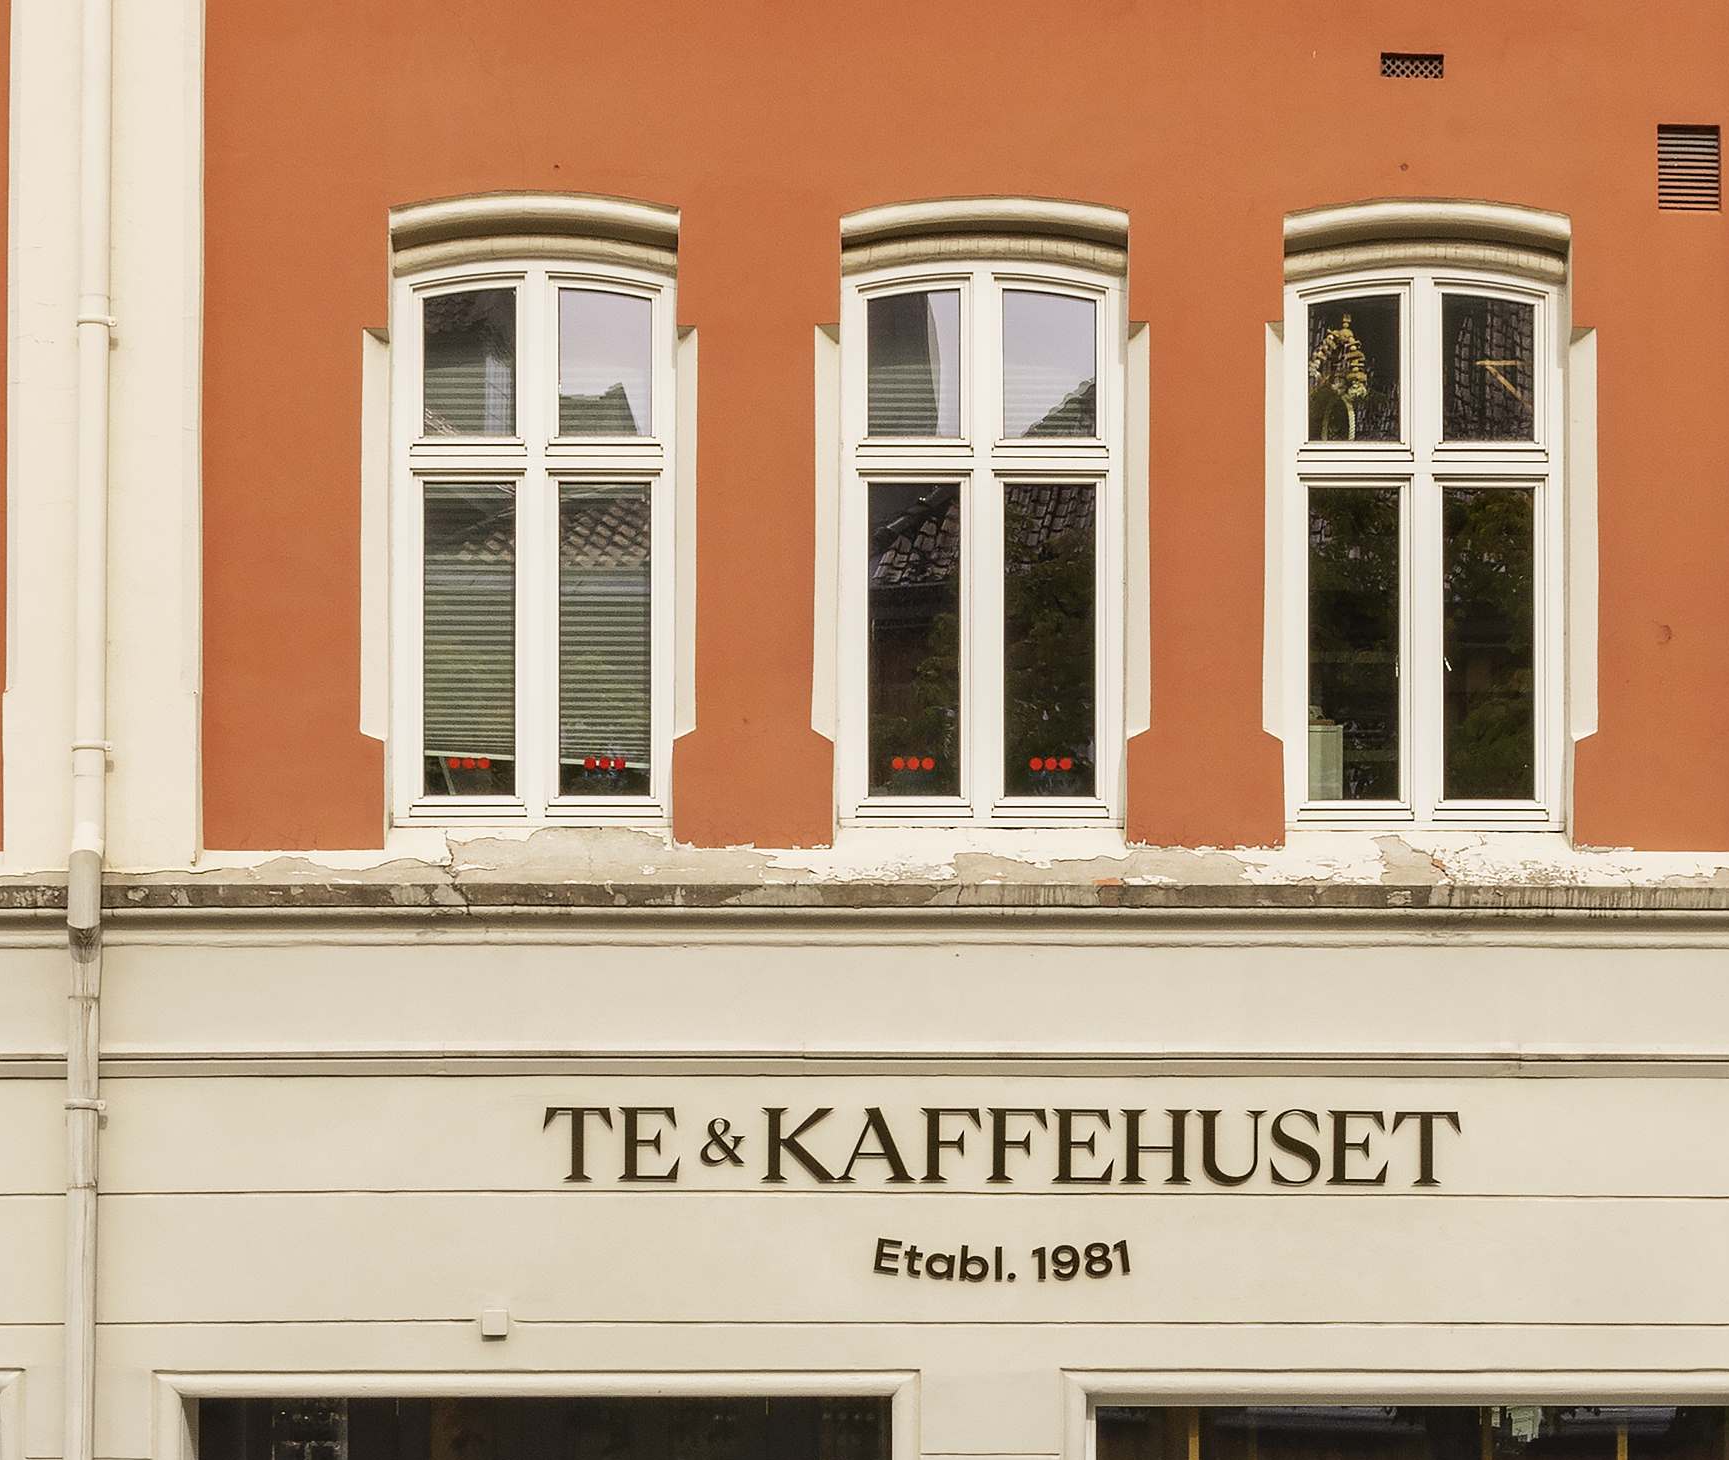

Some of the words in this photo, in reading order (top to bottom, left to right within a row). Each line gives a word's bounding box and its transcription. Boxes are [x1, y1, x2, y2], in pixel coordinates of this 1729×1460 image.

[543, 1106, 681, 1184] TE
[700, 1117, 746, 1167] &
[760, 1107, 1462, 1187] KAFFEHUSET
[873, 1237, 1017, 1283] Etabl.
[1030, 1239, 1132, 1283] 1981
